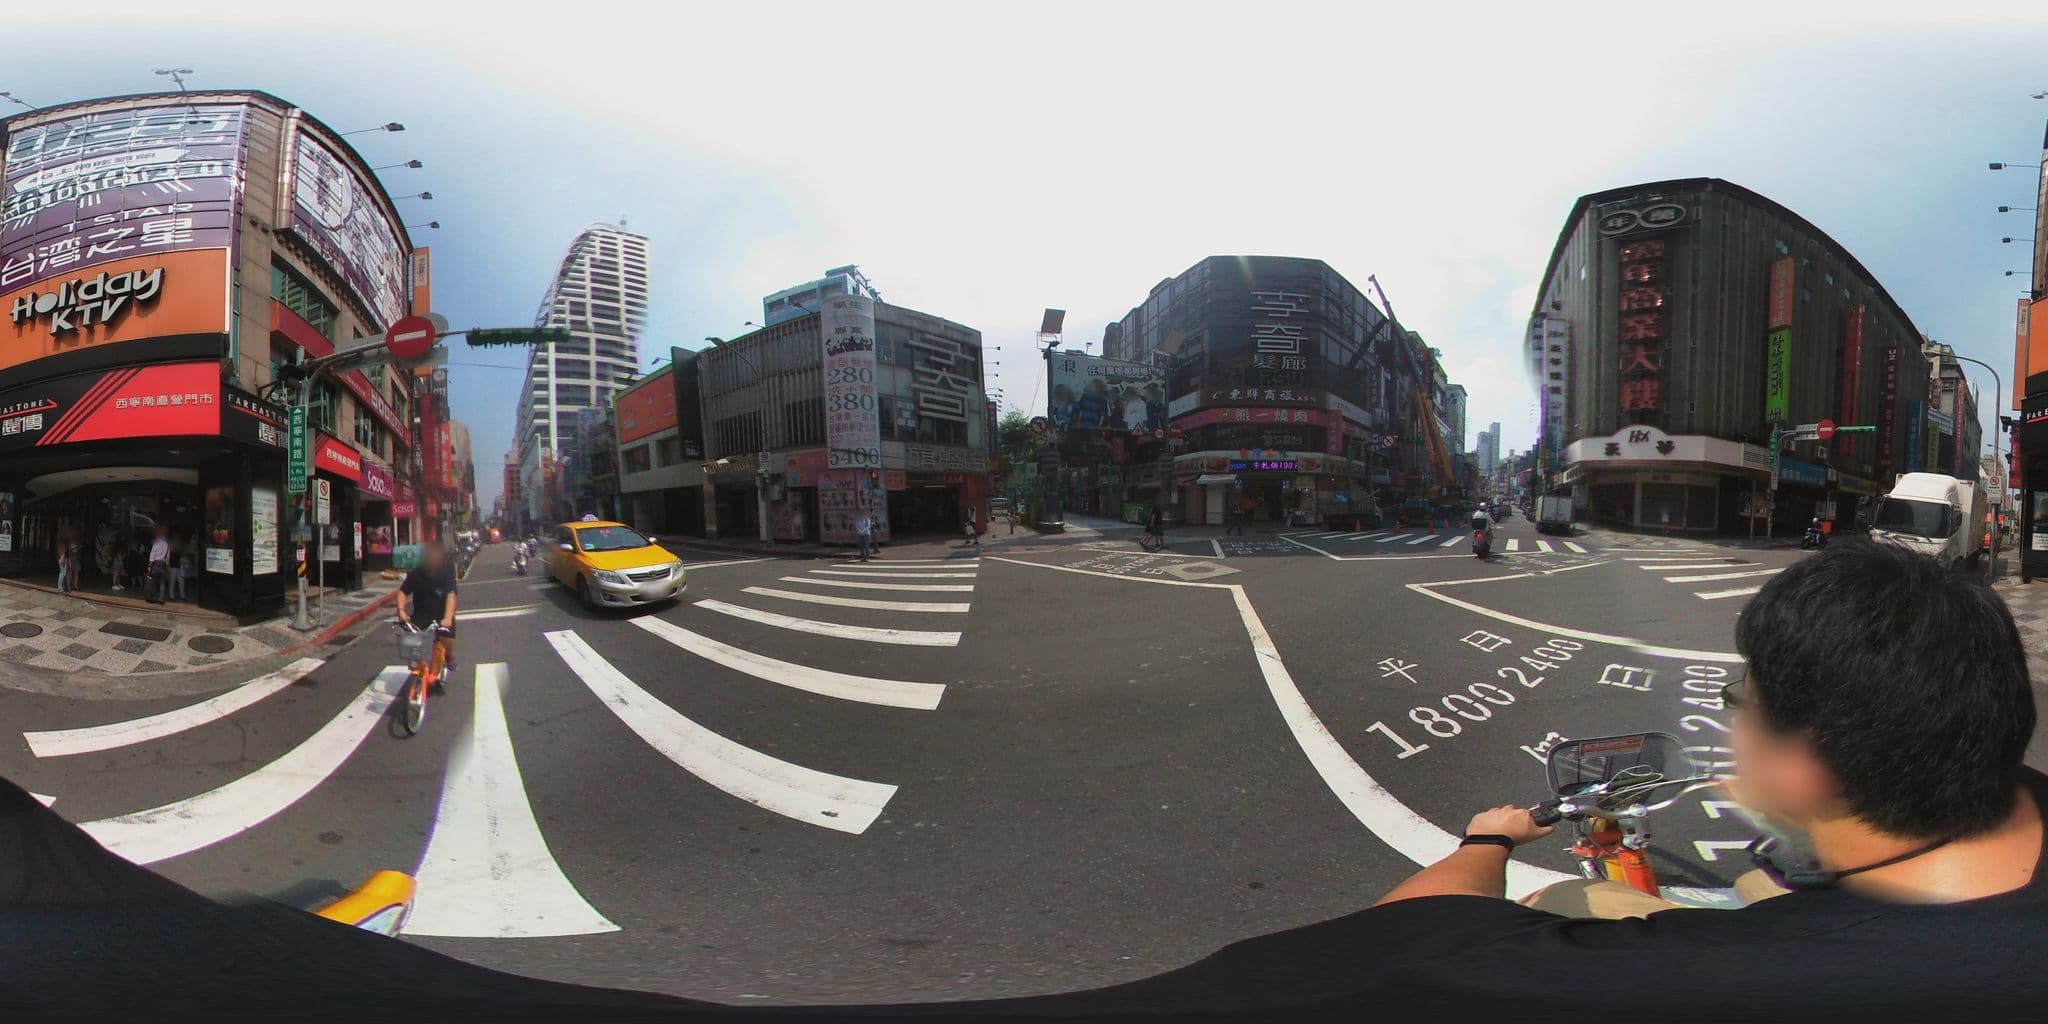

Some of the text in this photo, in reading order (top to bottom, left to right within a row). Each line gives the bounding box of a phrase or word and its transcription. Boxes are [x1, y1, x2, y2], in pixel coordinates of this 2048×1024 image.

[94, 203, 194, 226] STAR
[1, 217, 194, 287] 台灣之星
[9, 266, 165, 325] Holiday
[49, 295, 131, 337] KTV
[827, 366, 873, 384] 280
[115, 393, 213, 409] 西寧南直營門市
[829, 394, 874, 412] 380
[1365, 638, 1585, 760] 1800 2400
